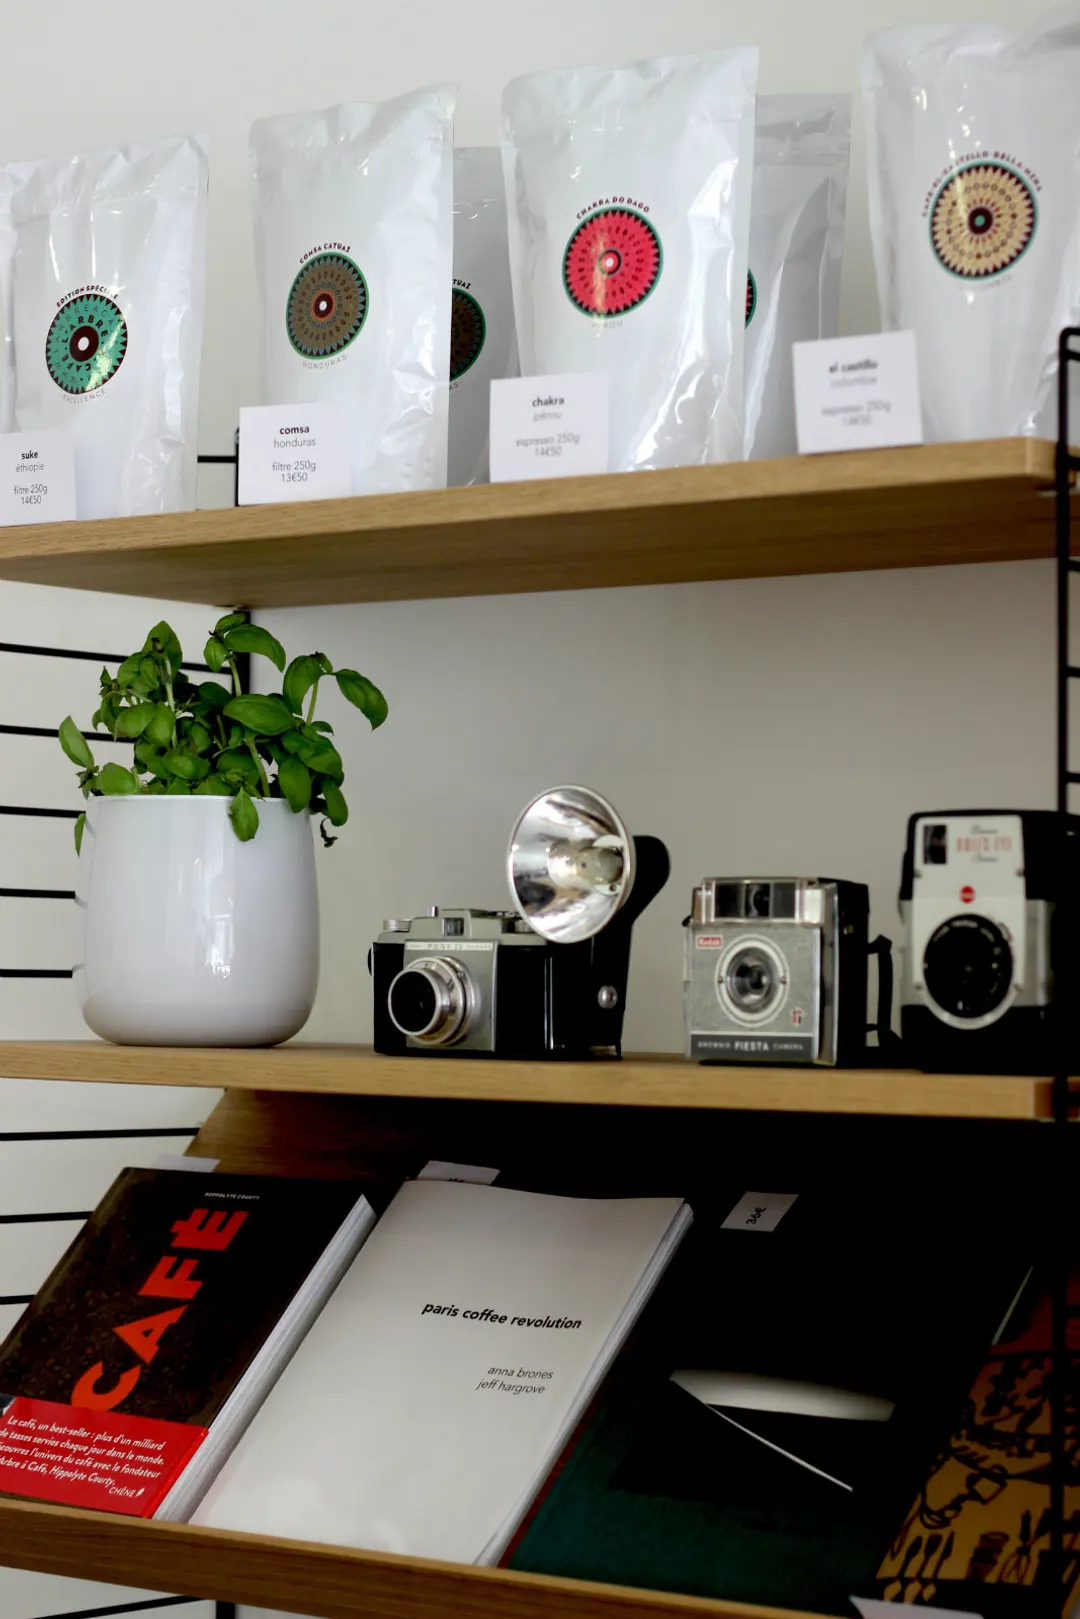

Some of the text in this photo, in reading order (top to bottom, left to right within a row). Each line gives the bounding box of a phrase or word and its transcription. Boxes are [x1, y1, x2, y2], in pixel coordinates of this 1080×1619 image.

[576, 196, 650, 219] CHAKRA DO DAGO
[299, 245, 323, 264] COMSA
[532, 394, 564, 408] chakra
[279, 426, 310, 435] comsa
[273, 436, 316, 448] honduras
[21, 450, 38, 460] suke
[15, 462, 45, 473] éthiopie
[272, 460, 316, 472] filtre 250g
[281, 472, 308, 482] 13€50
[14, 483, 48, 495] filtre 250g
[21, 494, 41, 505] 14€50
[734, 1041, 769, 1051] FIESTA
[745, 1206, 767, 1225] 36€
[421, 1303, 582, 1329] paris coffee revolution
[487, 1366, 554, 1380] anna brones
[475, 1378, 546, 1396] jeff hargrove
[7, 1415, 18, 1425] Le
[18, 1418, 37, 1431] café,
[49, 1422, 91, 1438] best-seller
[93, 1431, 113, 1443] plus
[113, 1434, 131, 1445] d'un
[132, 1438, 167, 1451] milliard
[8, 1431, 33, 1442] tasses
[32, 1436, 60, 1447] servies
[60, 1439, 89, 1453] chaque
[84, 1444, 106, 1456] jour
[106, 1447, 126, 1459] dans
[126, 1450, 135, 1460] le
[135, 1454, 164, 1466] monde.
[30, 1447, 63, 1461] l'univers
[63, 1454, 75, 1464] du
[74, 1456, 94, 1467] café
[92, 1461, 112, 1470] avec
[112, 1462, 121, 1472] le
[121, 1463, 162, 1478] fondateur
[20, 1460, 28, 1470] à
[27, 1461, 48, 1475] Café,
[48, 1465, 88, 1482] Hippolyte
[87, 1472, 115, 1489] Courty.
[108, 1485, 137, 1498] CHÊNE
